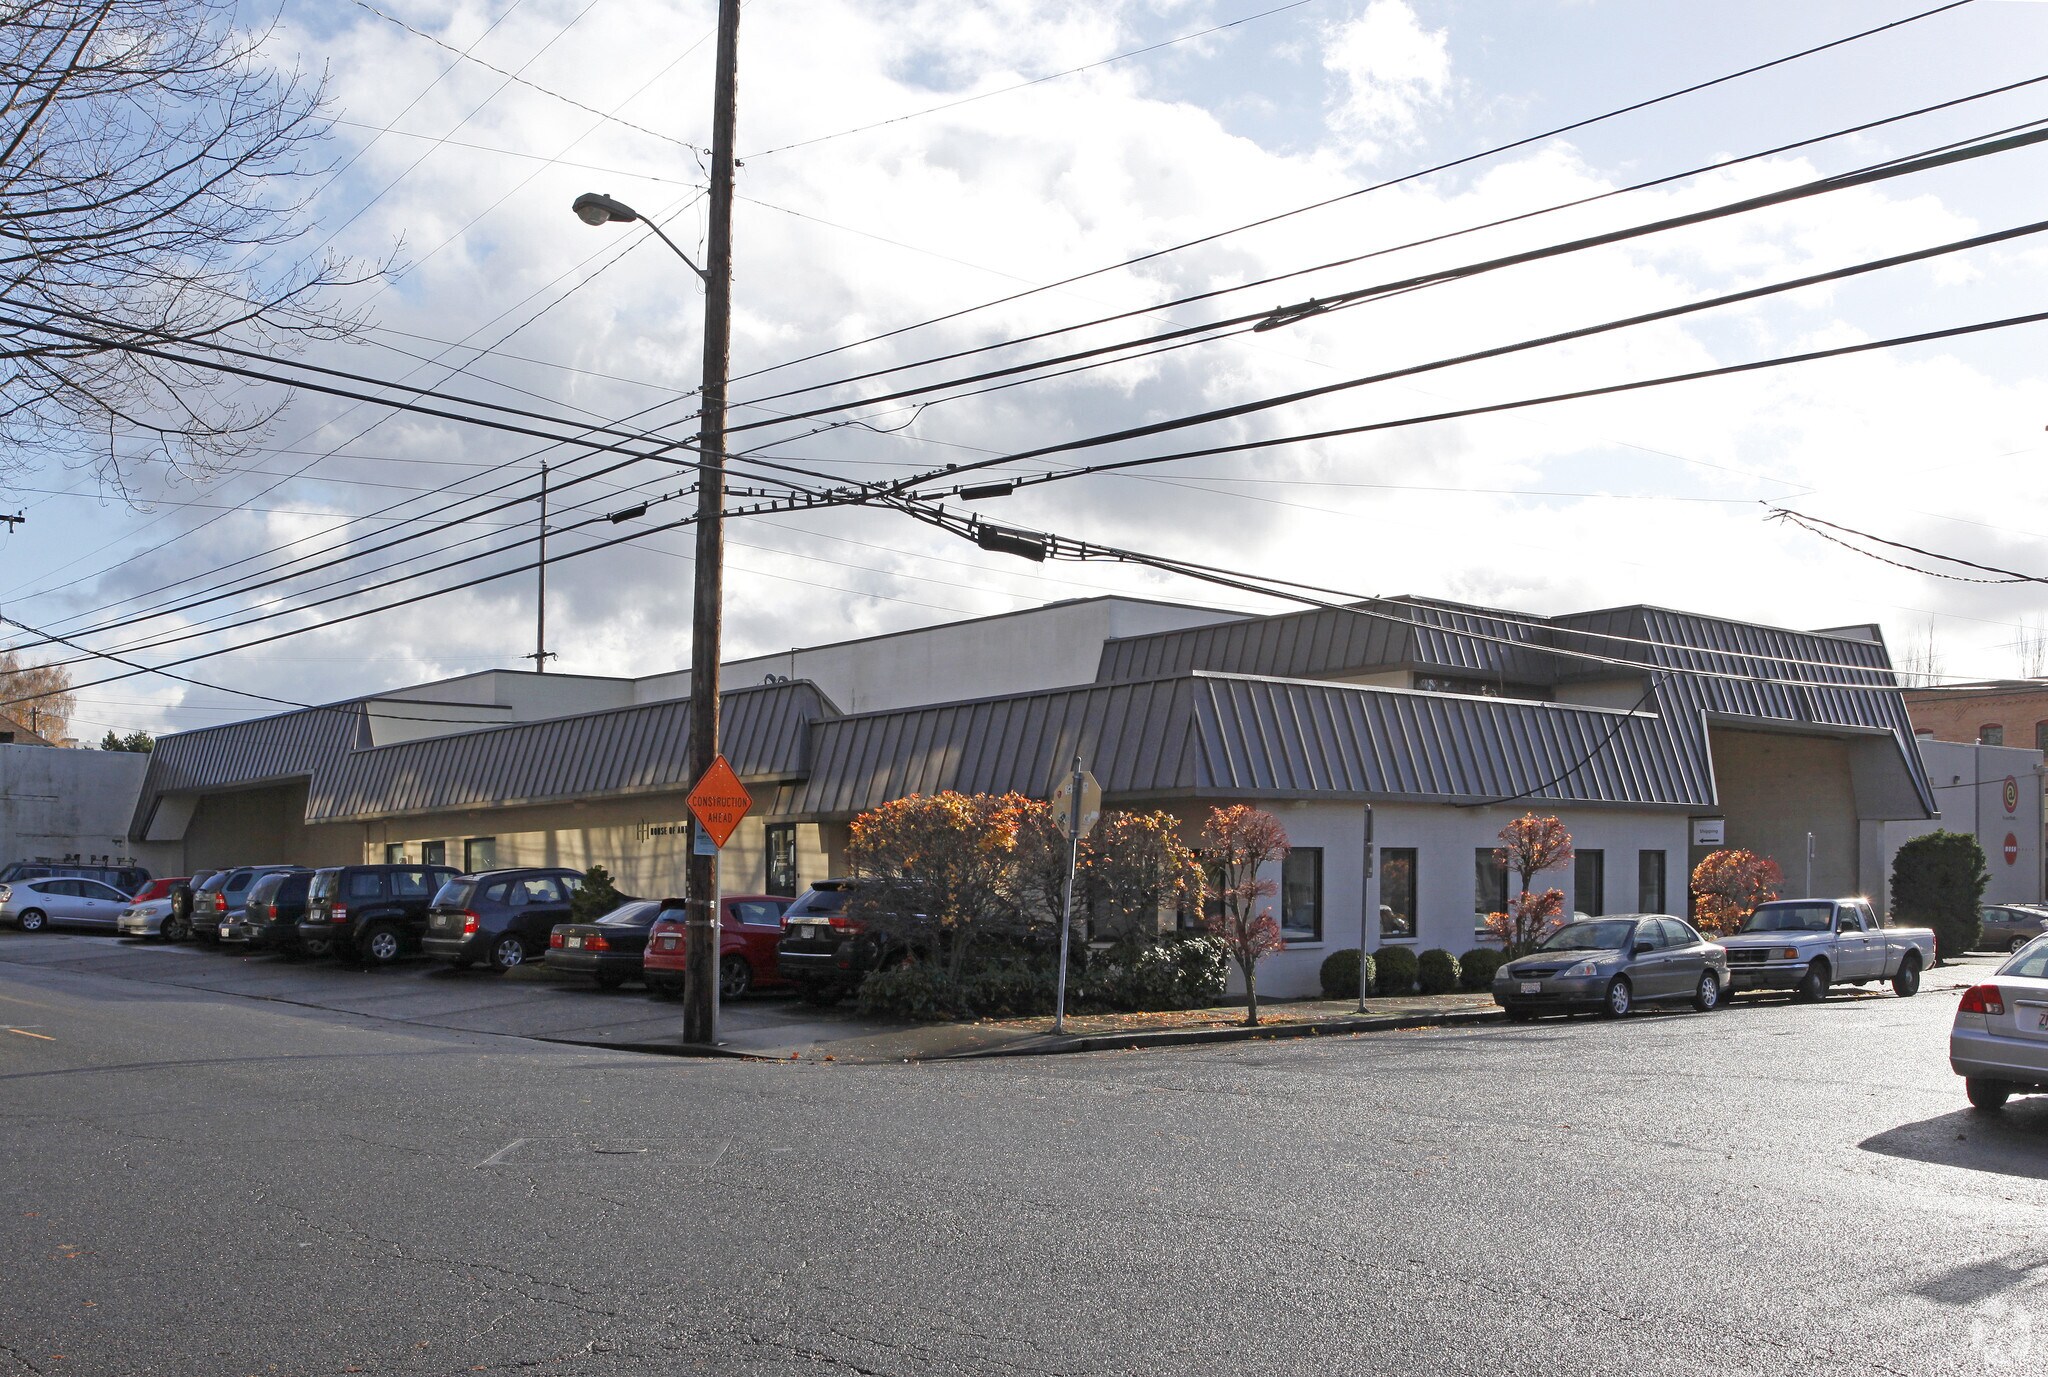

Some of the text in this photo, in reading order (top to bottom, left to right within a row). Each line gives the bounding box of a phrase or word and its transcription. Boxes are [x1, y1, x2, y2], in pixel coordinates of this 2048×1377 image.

[692, 796, 747, 808] CONSTRUCTION
[708, 812, 733, 823] AHEAD
[650, 827, 667, 836] HOUSE
[668, 826, 676, 835] OF
